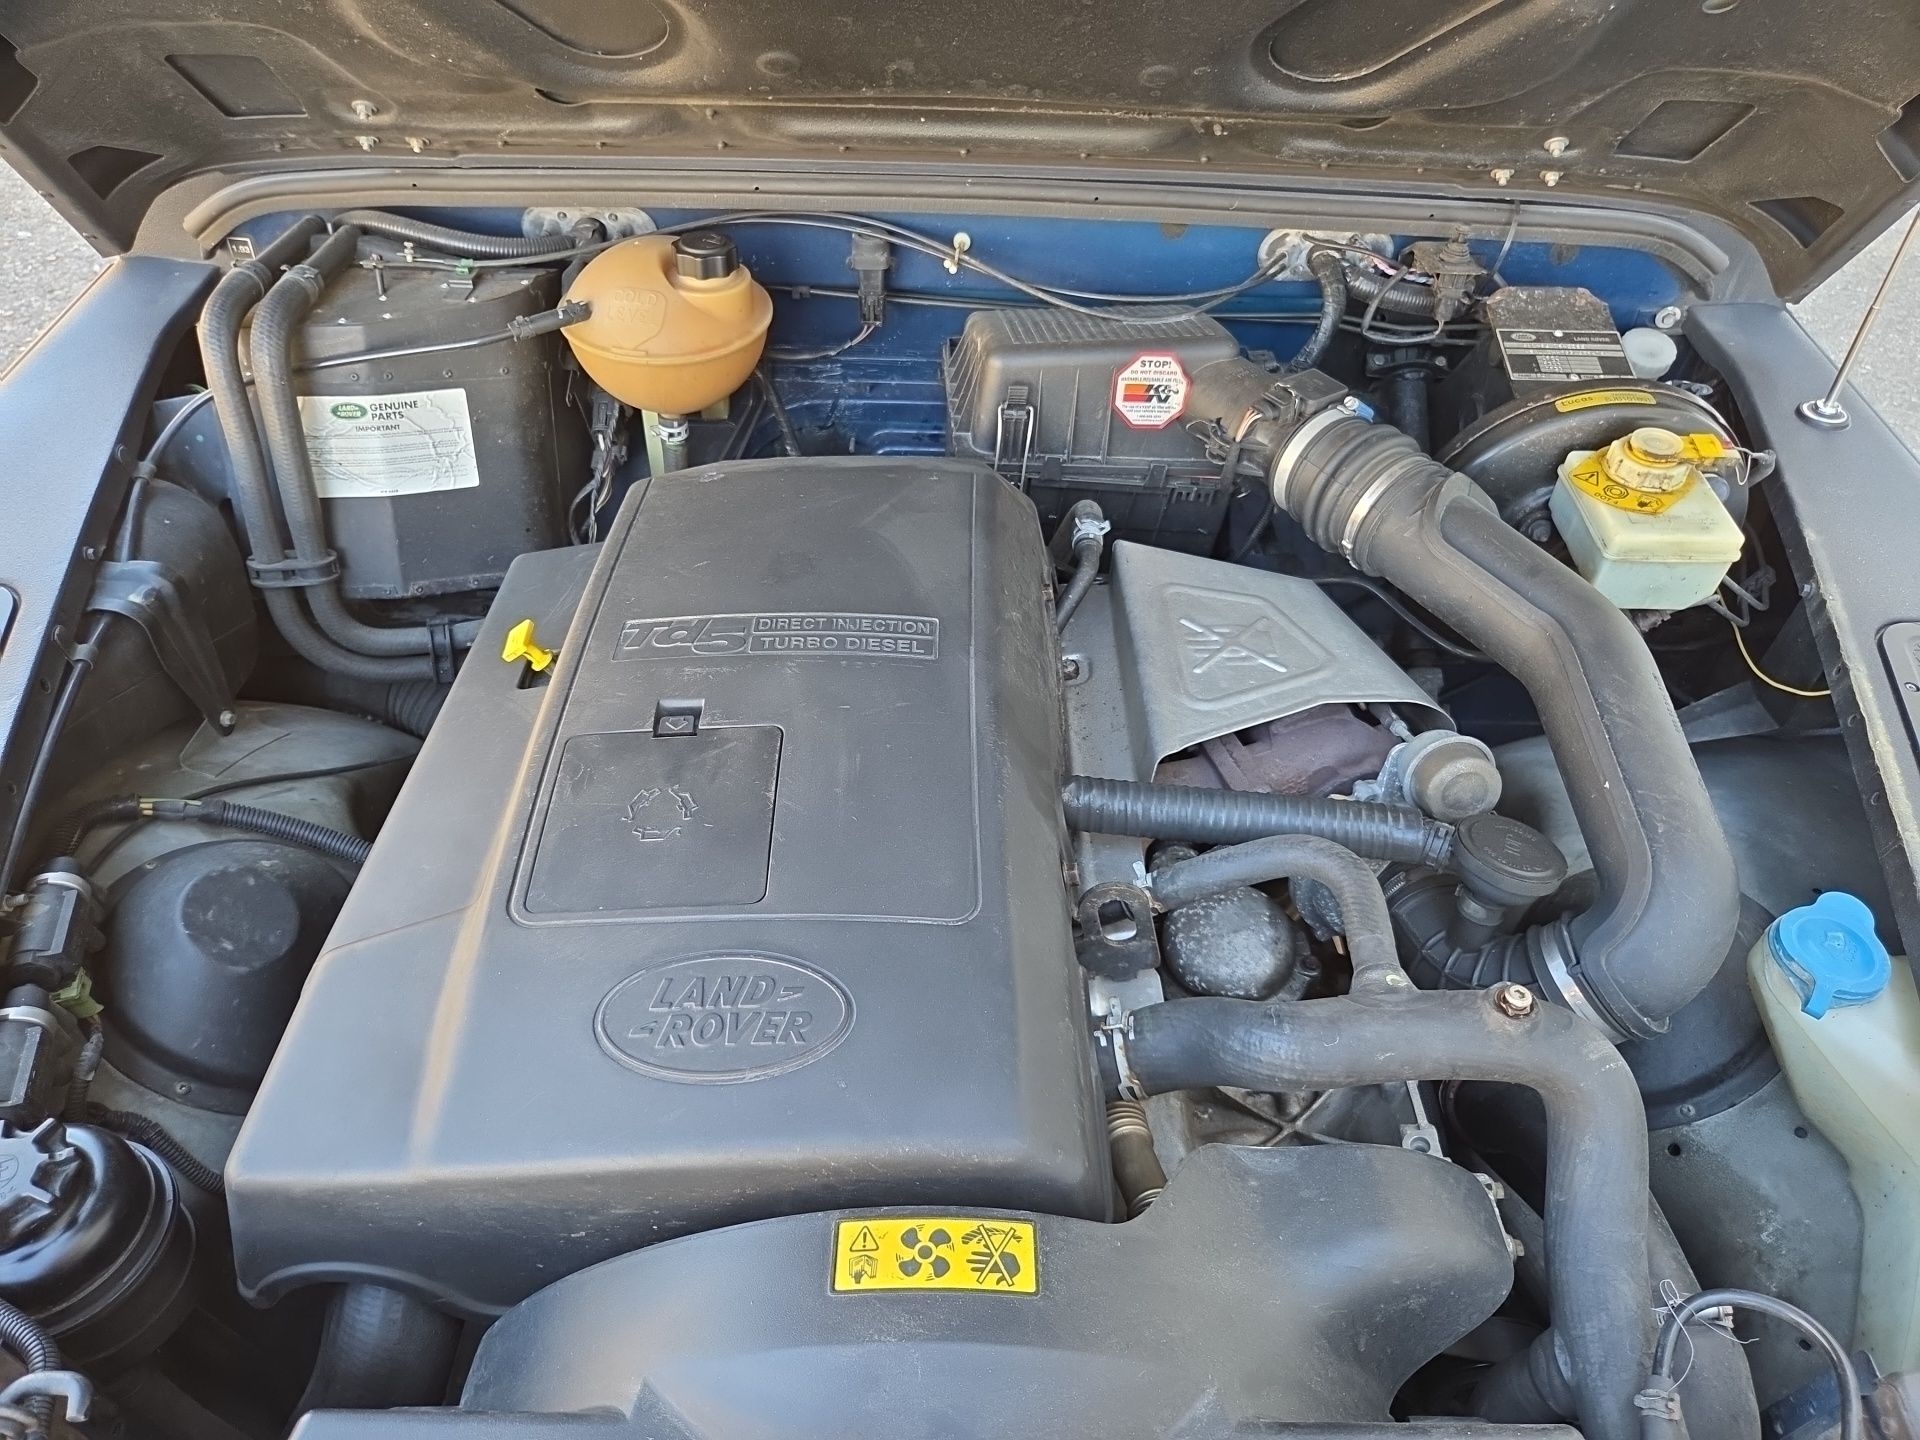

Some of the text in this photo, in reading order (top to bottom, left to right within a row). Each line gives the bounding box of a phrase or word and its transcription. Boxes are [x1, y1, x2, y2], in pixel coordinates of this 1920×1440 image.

[1140, 360, 1172, 369] STOP!
[369, 400, 419, 412] GENUINE
[371, 411, 404, 421] PARTS
[355, 424, 400, 433] IMPORTANT
[757, 617, 931, 635] DIRECT INJECTION
[623, 619, 748, 654] Td5
[760, 636, 926, 653] TURBO DIESEL
[648, 976, 776, 1011] LAND
[654, 1010, 814, 1049] ROVER
